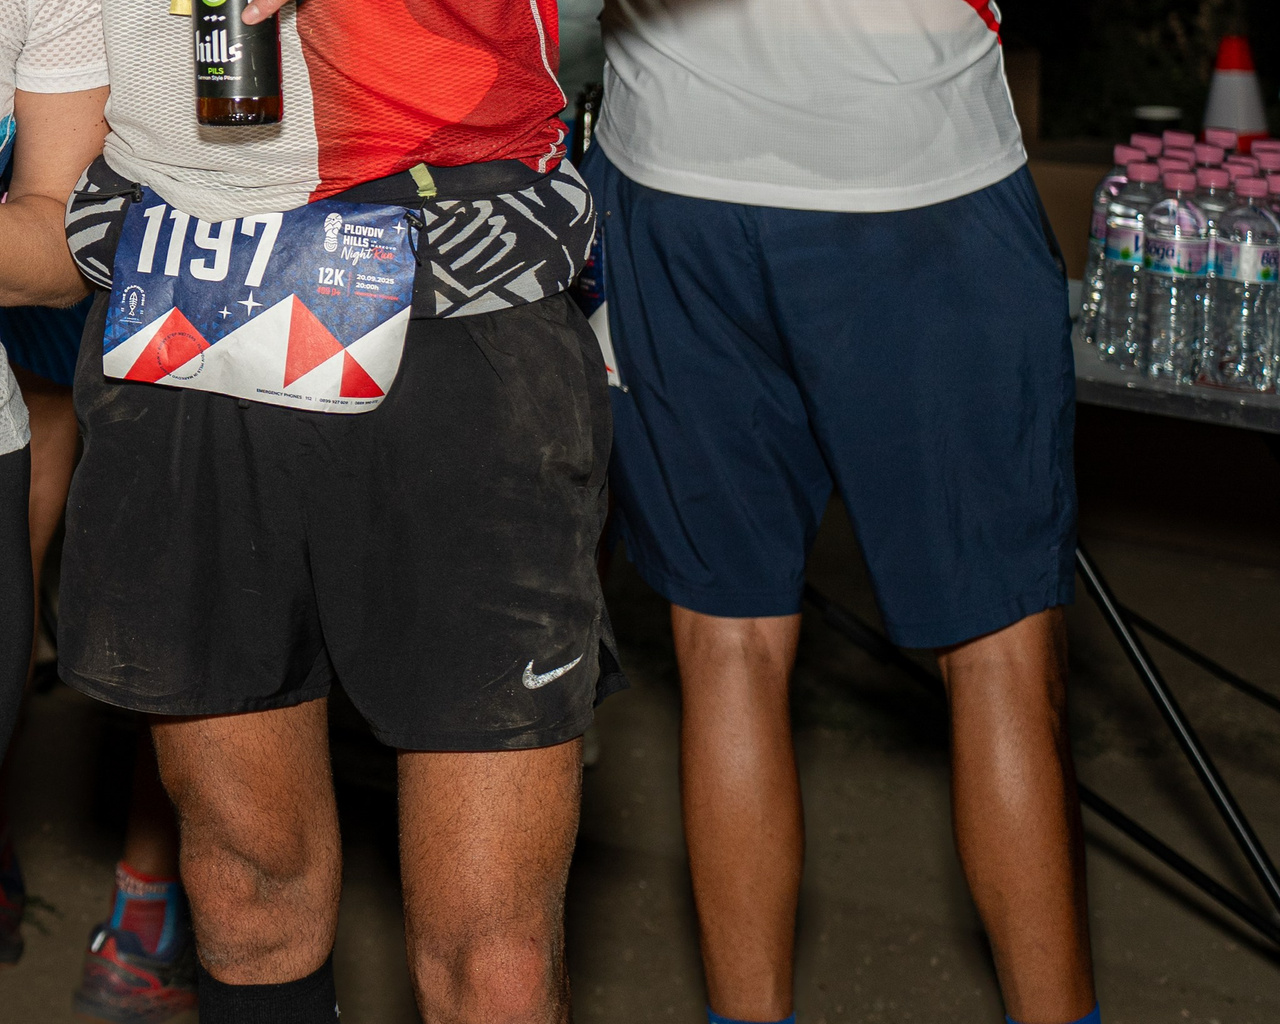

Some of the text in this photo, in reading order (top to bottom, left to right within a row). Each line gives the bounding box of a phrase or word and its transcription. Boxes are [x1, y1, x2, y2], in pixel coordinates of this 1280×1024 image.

[195, 29, 243, 63] hills
[207, 67, 224, 75] PILS
[344, 224, 384, 238] PLOVDIV
[137, 203, 284, 287] 1197
[343, 235, 369, 248] HILLS
[340, 246, 395, 266] Night Run
[318, 267, 345, 287] 12K
[356, 274, 395, 284] 20.09.2025
[355, 282, 379, 291] 20:00h
[256, 388, 283, 396] EMERGENCY
